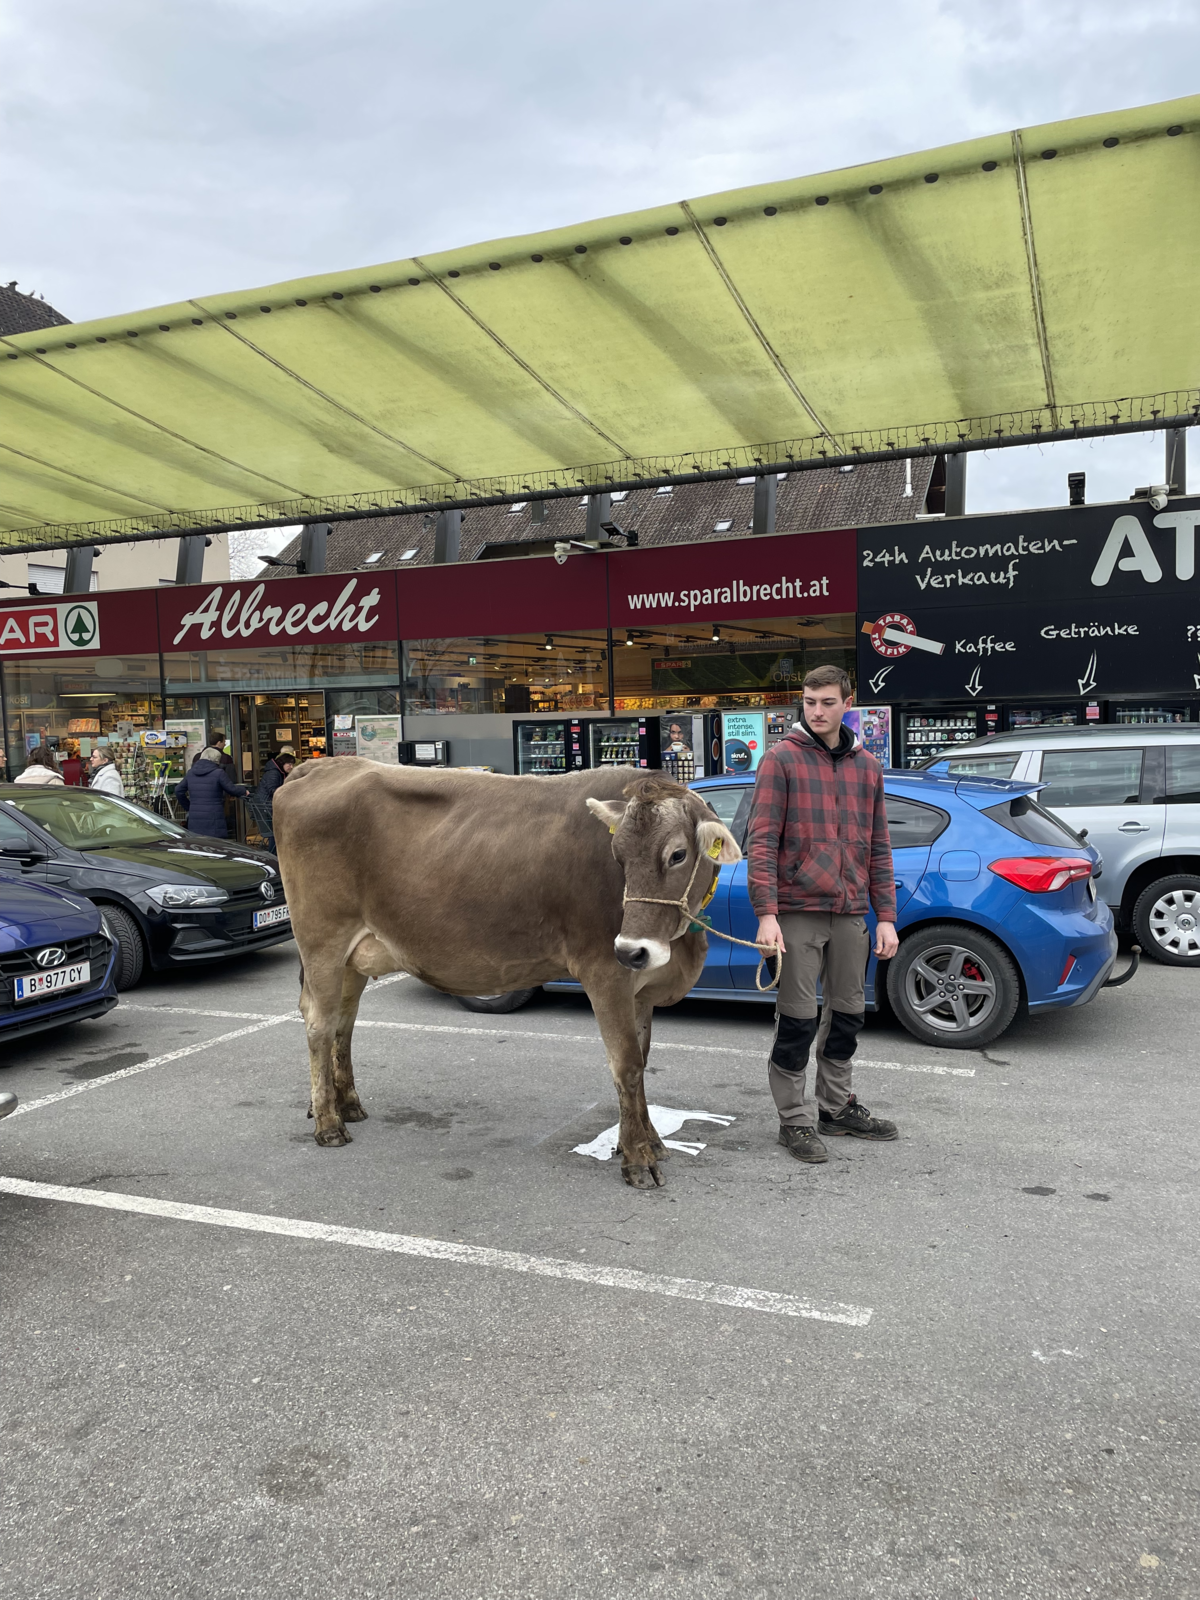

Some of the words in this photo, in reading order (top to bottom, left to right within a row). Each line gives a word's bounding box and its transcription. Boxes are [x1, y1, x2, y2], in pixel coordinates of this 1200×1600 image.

[862, 546, 909, 567] 24h
[918, 534, 1078, 563] Automaten-
[915, 558, 1020, 590] Verkauf
[627, 575, 830, 611] www.sparalbrecht.at
[173, 577, 381, 645] Albrecht
[878, 614, 914, 633] TABAK
[1040, 621, 1140, 639] Getränke
[872, 632, 907, 655] TRAFIK
[954, 635, 1017, 657] Kaffee
[773, 671, 802, 682] Obst
[29, 978, 37, 993] B
[46, 971, 66, 988] 977
[69, 966, 83, 982] CY
